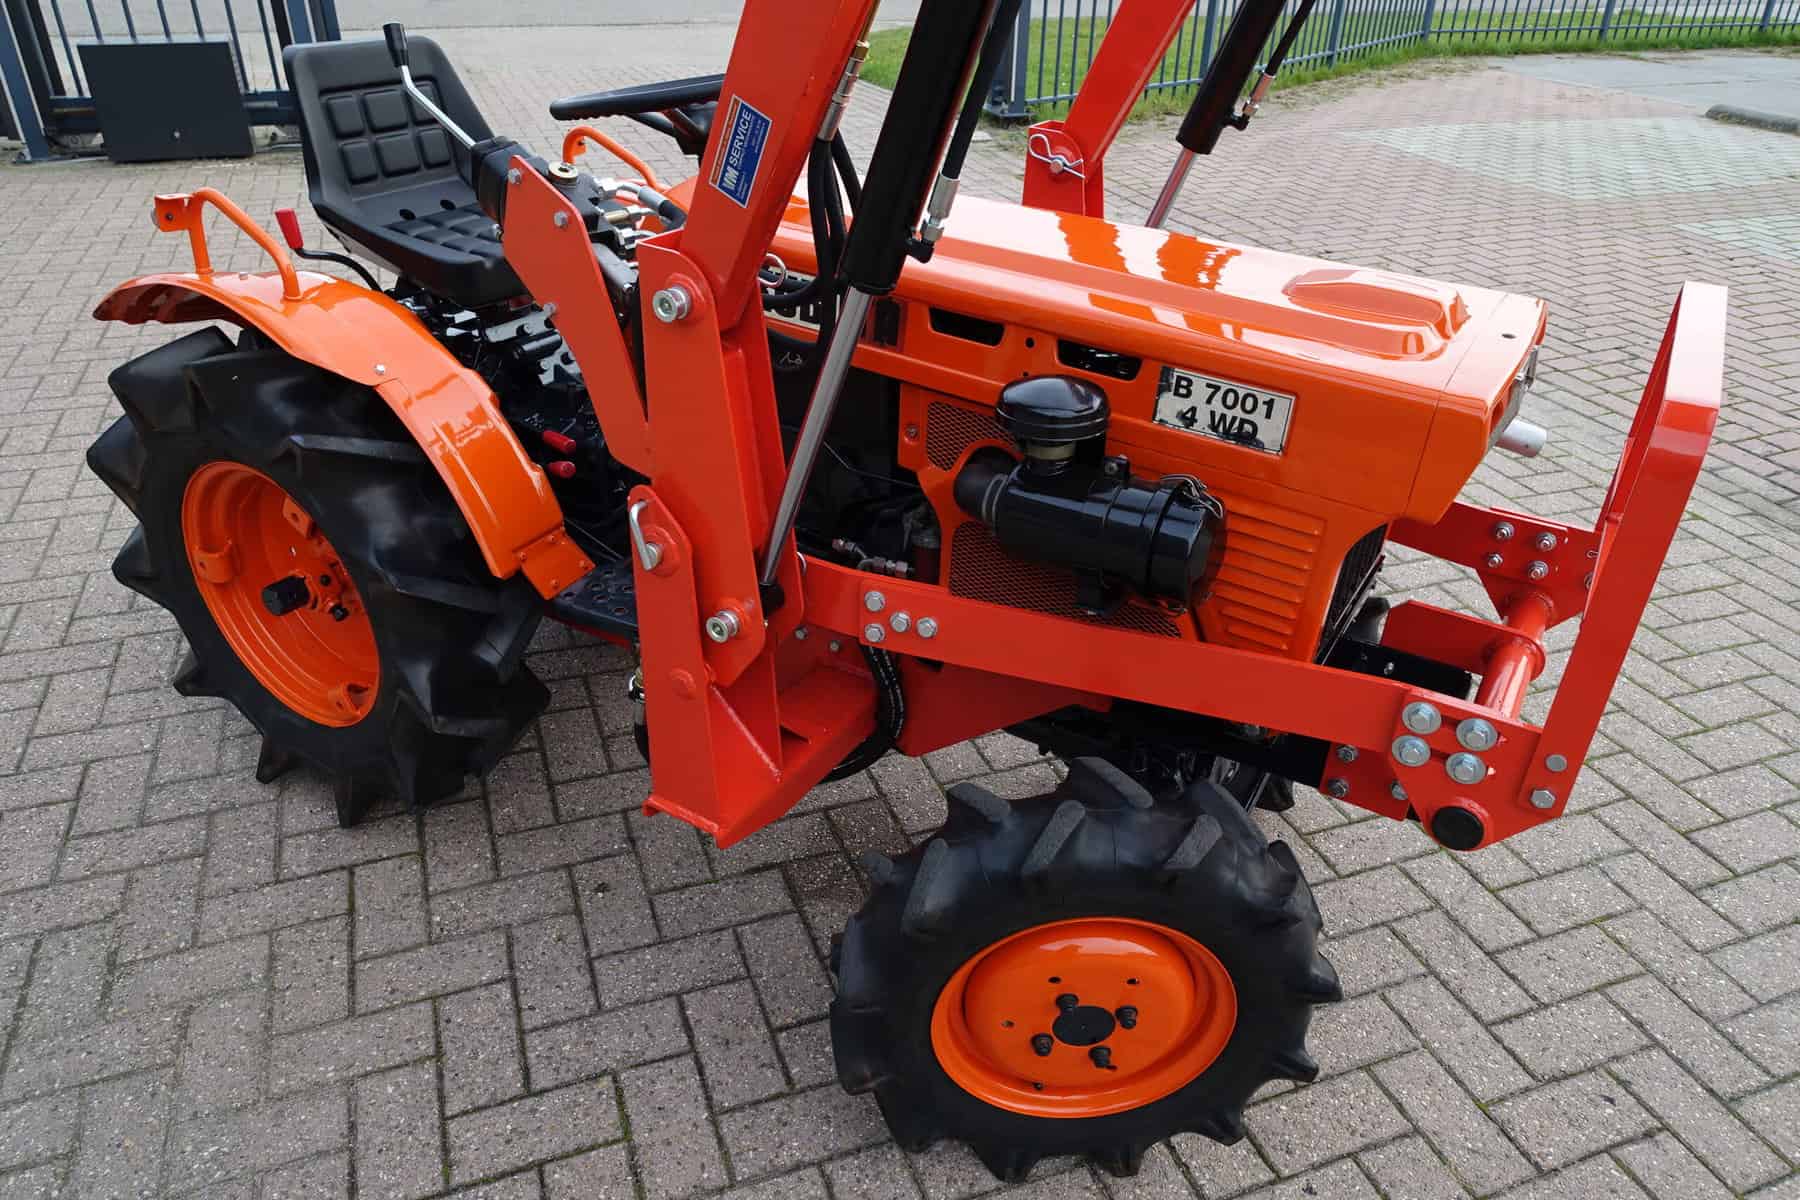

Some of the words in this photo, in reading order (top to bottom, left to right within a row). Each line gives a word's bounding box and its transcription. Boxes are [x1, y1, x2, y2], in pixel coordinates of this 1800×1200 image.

[729, 109, 752, 167] SERVICE
[1173, 375, 1193, 399] B
[1205, 382, 1275, 420] 7001
[1179, 406, 1198, 428] 4
[1210, 410, 1258, 440] WD
